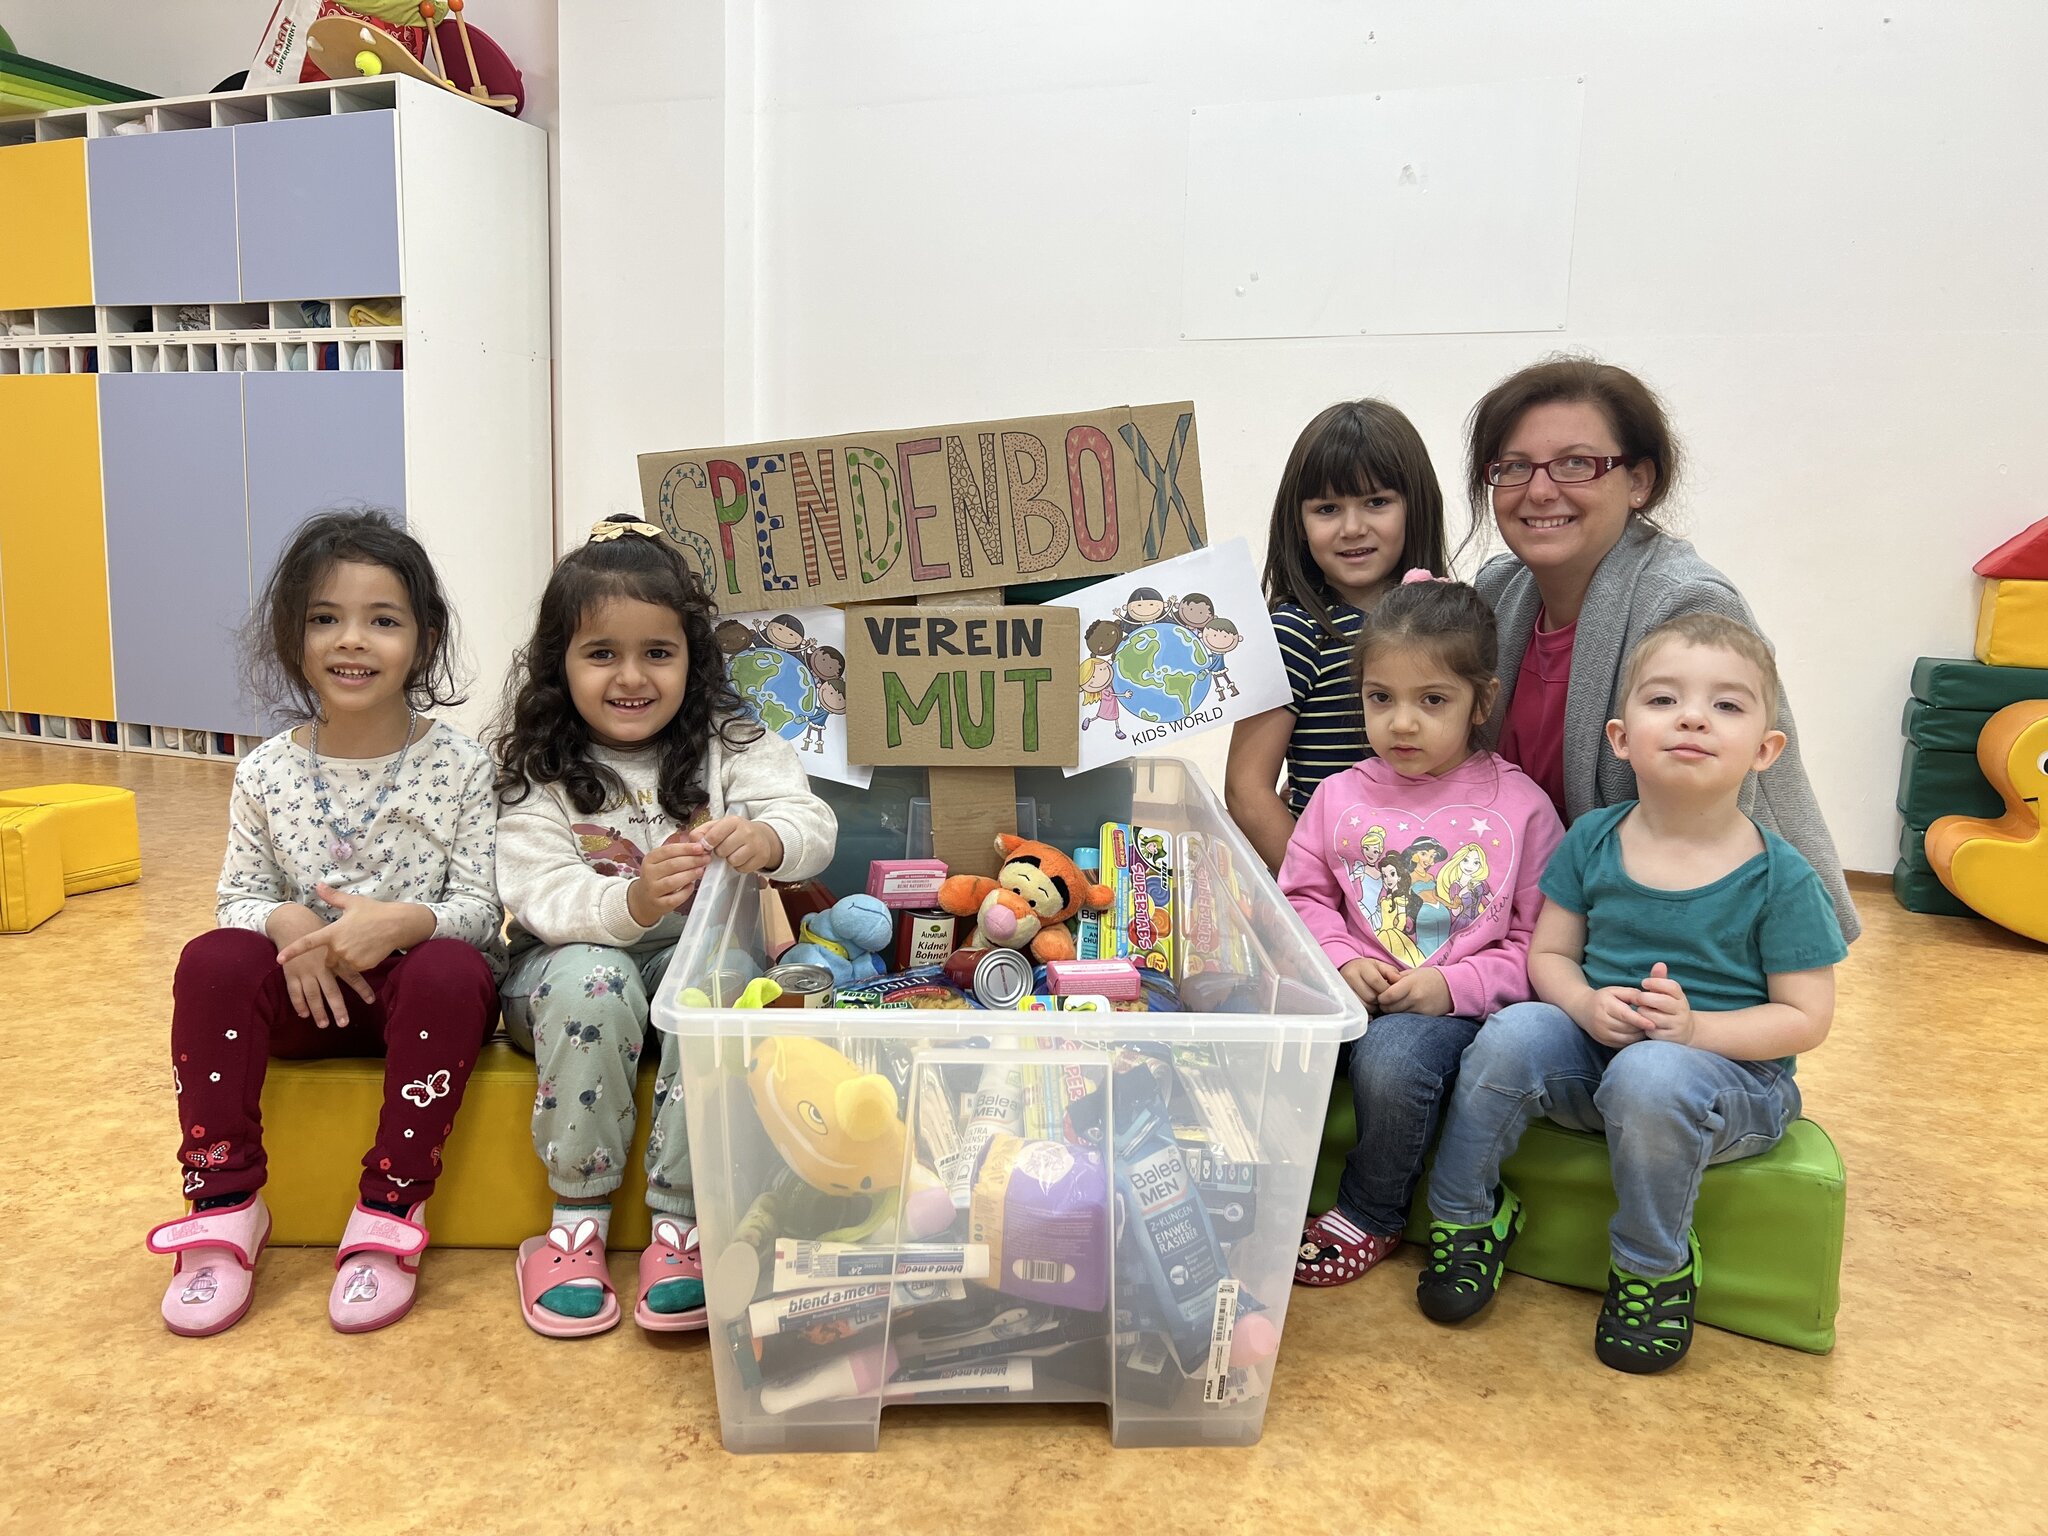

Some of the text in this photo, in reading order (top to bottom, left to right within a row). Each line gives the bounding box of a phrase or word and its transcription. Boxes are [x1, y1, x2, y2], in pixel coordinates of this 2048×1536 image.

[275, 23, 296, 74] SUPERMARKT
[658, 413, 1201, 595] SPENDENBOX
[864, 616, 1044, 658] VEREIN
[882, 668, 1051, 753] MUT
[1131, 706, 1224, 746] KIDS WORLD
[1131, 862, 1153, 950] SUPERTABS
[915, 950, 949, 960] Bohnen
[917, 941, 949, 951] Kidney
[1153, 957, 1165, 971] 12
[973, 1106, 1007, 1118] MEN
[976, 1094, 1019, 1112] Balea
[1130, 1158, 1182, 1190] Balea
[1139, 1177, 1179, 1206] MEN
[1150, 1204, 1193, 1232] 2-KLINGEN
[1154, 1219, 1192, 1245] EINWEG
[1158, 1227, 1198, 1254] RASIERER
